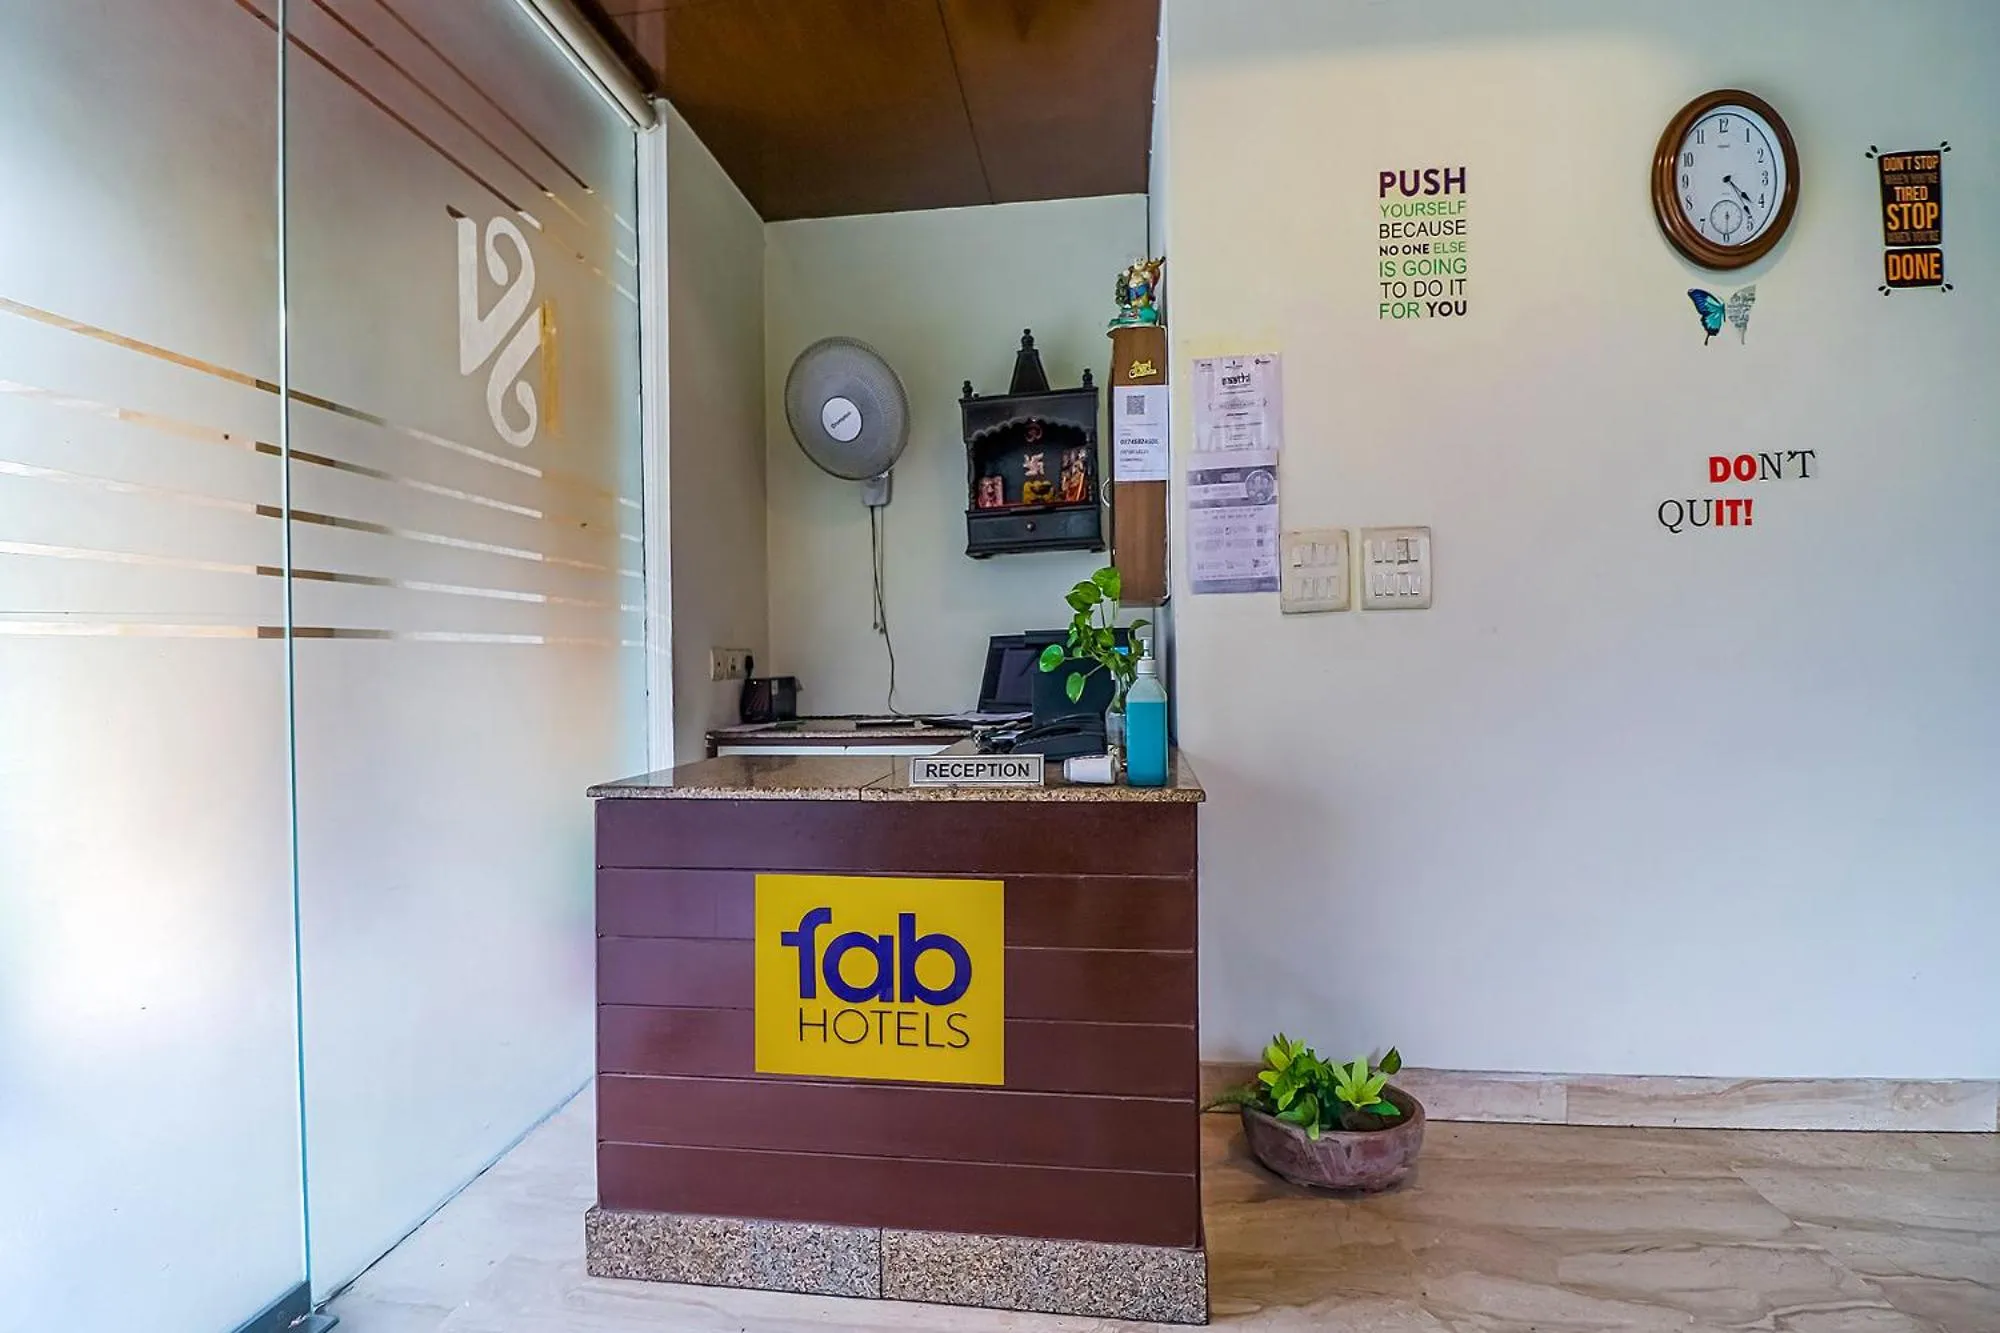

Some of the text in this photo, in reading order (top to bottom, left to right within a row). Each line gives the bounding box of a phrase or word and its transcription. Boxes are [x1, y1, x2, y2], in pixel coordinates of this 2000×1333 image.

[1719, 118, 1729, 133] 12
[1696, 129, 1704, 145] 11
[1745, 128, 1751, 143] 1
[1683, 152, 1694, 168] 10
[1757, 148, 1764, 164] 2
[1914, 154, 1939, 171] STOP
[1379, 167, 1467, 198] PUSH
[1682, 175, 1689, 189] 9
[1762, 172, 1769, 186] 3
[1758, 193, 1765, 208] 4
[1893, 186, 1929, 202] TIRED
[1380, 200, 1467, 219] YOURSELF
[1685, 197, 1693, 210] 8
[1746, 216, 1754, 232] 5
[1887, 202, 1939, 231] STOP
[1379, 220, 1467, 239] BECAUSE
[1699, 218, 1706, 234] 7
[1379, 241, 1467, 257] NO ONE ELSE
[1379, 258, 1467, 278] IS GOING
[1888, 252, 1942, 281] DONE
[1380, 278, 1467, 299] TO DO IT
[1379, 300, 1467, 320] FOR YOU
[1708, 449, 1816, 483] DON'T
[1657, 498, 1754, 534] QUIT!
[925, 762, 1031, 779] RECEPTION
[780, 906, 972, 1006] fab
[799, 1007, 970, 1049] HOTELS
